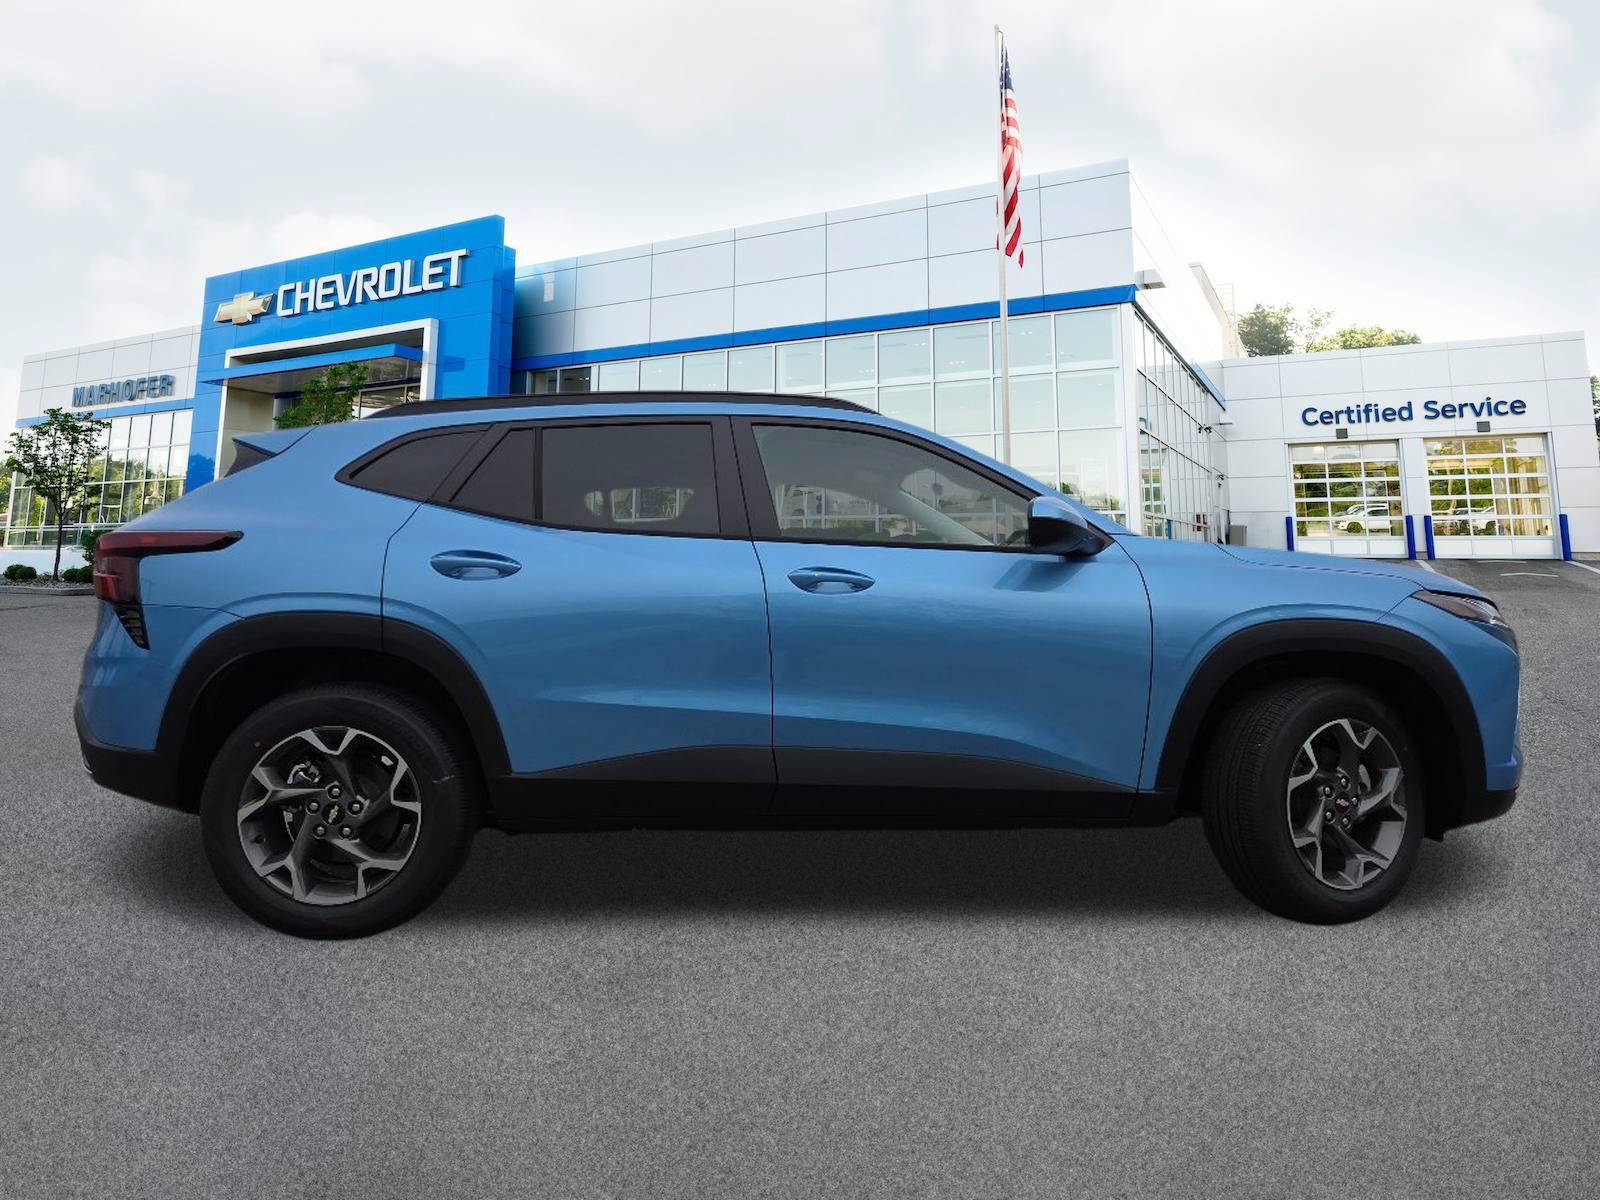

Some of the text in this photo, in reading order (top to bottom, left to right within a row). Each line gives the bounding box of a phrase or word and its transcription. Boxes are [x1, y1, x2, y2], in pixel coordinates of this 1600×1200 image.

[276, 248, 469, 317] CHEVROLET
[72, 374, 175, 407] MARHOFER
[1301, 396, 1527, 426] Certified Service
